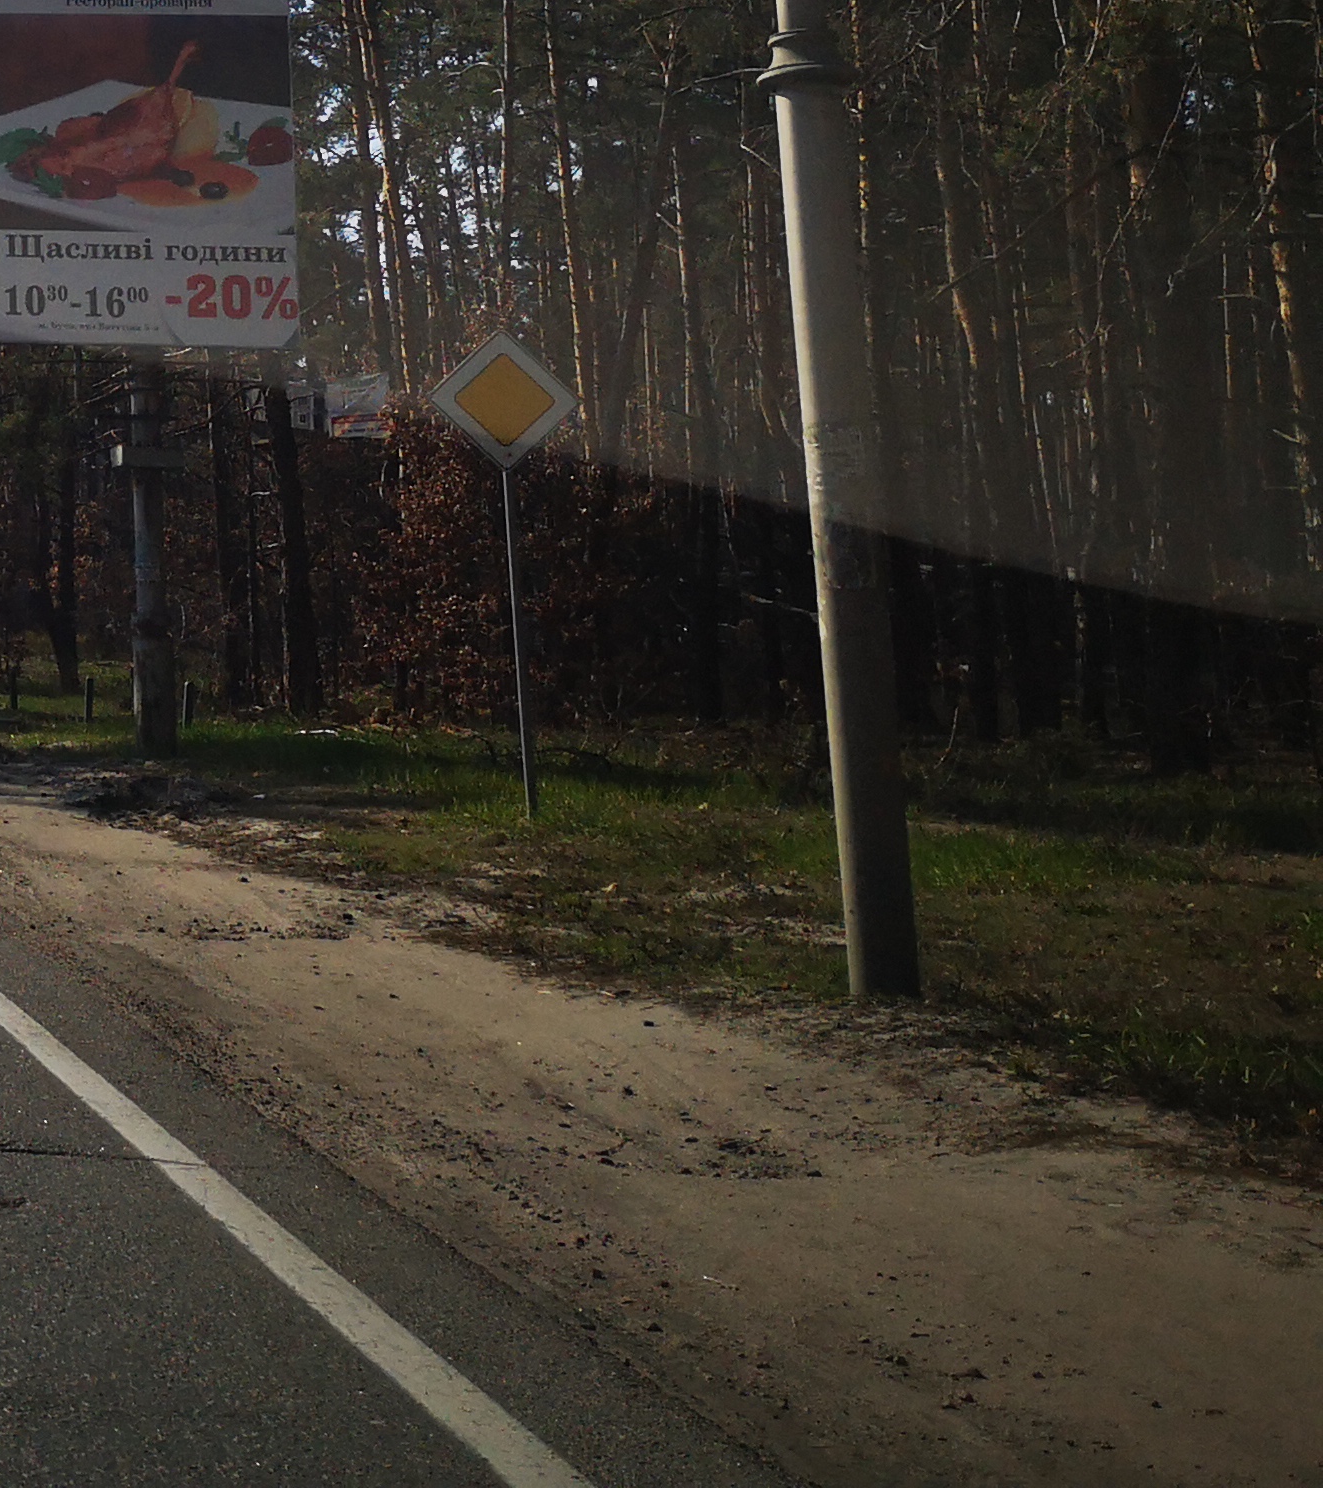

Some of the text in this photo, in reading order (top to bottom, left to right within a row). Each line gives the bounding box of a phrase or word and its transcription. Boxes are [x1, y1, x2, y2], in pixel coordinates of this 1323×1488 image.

[5, 233, 287, 266] Щасливі години
[165, 273, 299, 320] -20%
